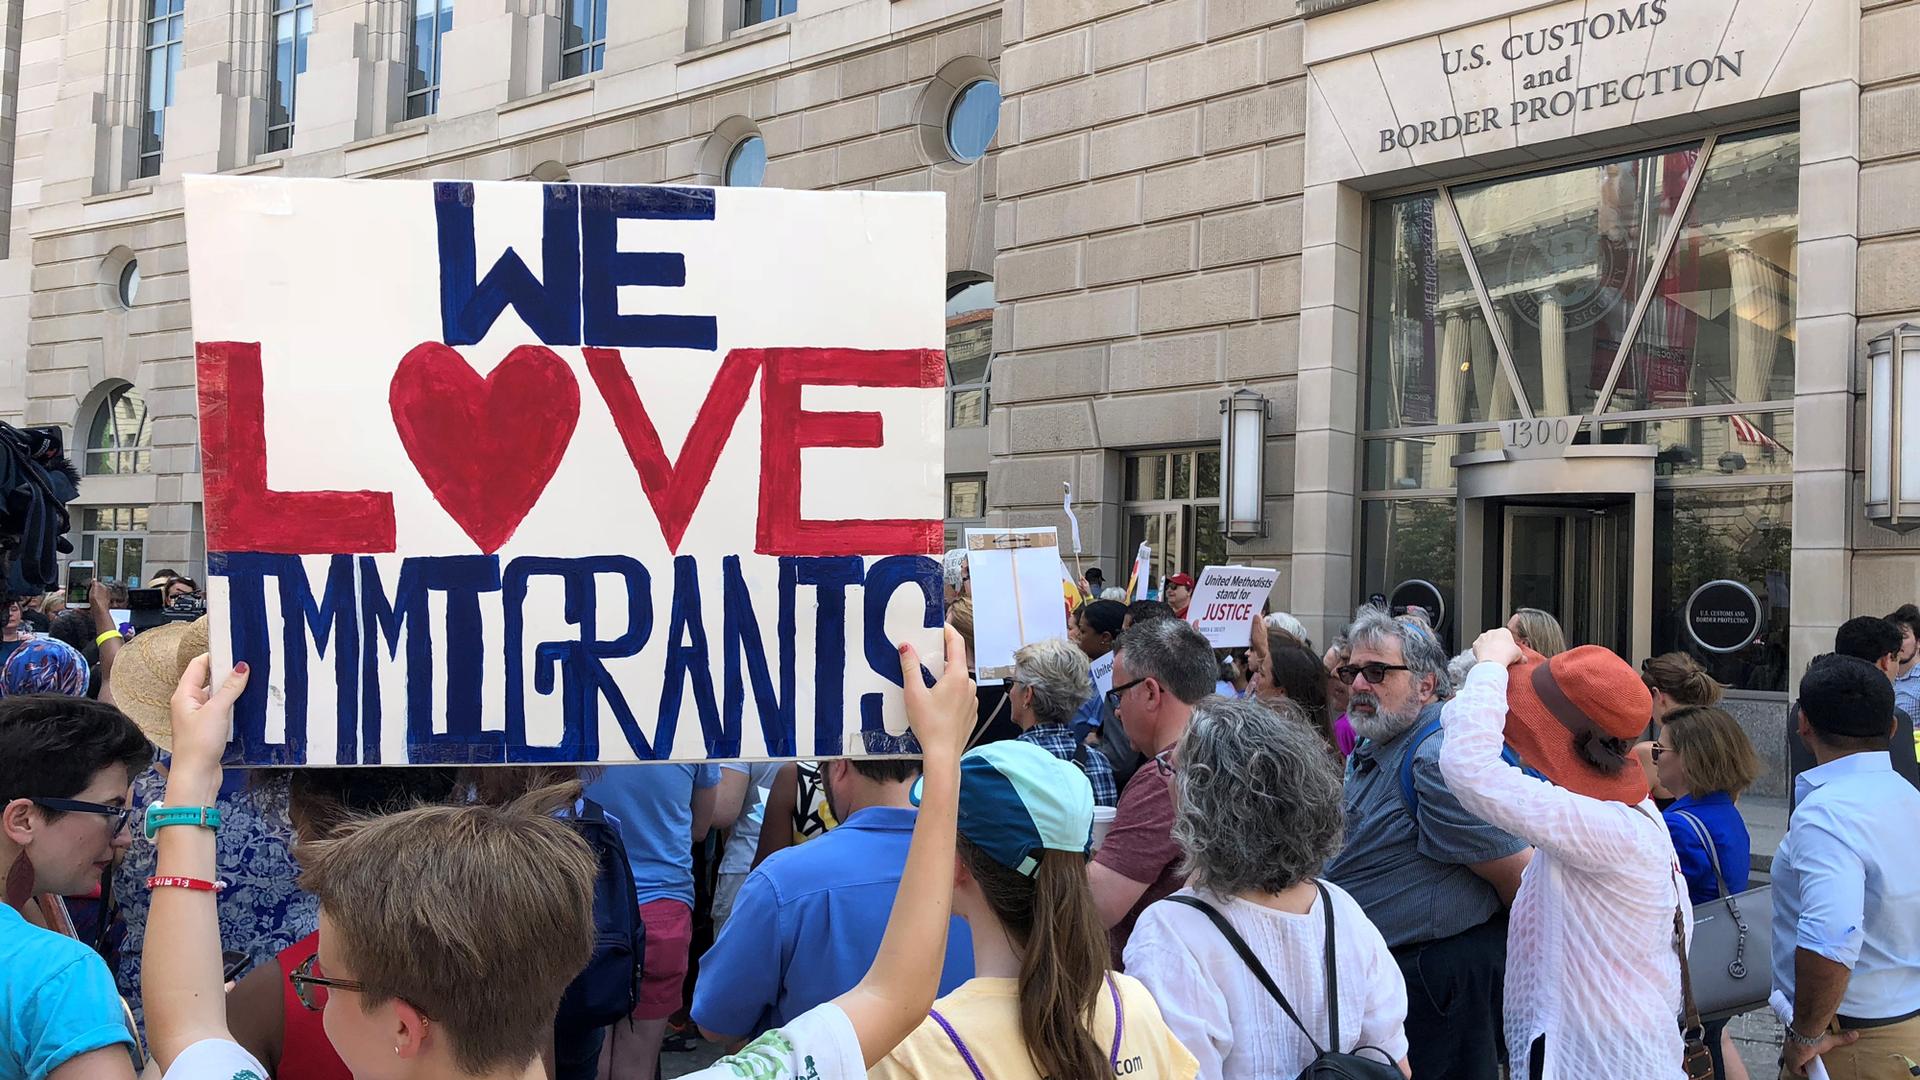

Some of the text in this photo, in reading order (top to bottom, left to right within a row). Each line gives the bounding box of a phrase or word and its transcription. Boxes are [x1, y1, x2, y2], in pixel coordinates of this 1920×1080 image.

[1441, 0, 1667, 75] U.S. CUSTOMS
[1522, 55, 1573, 90] and
[1379, 50, 1745, 152] BORDER PROTECTION
[434, 182, 717, 350] WE
[1508, 420, 1568, 449] 1300
[1205, 575, 1273, 588] United Methodists
[1215, 589, 1251, 600] stand for
[1202, 603, 1252, 621] JUSTICE
[208, 551, 945, 764] IMMIGRANTS
